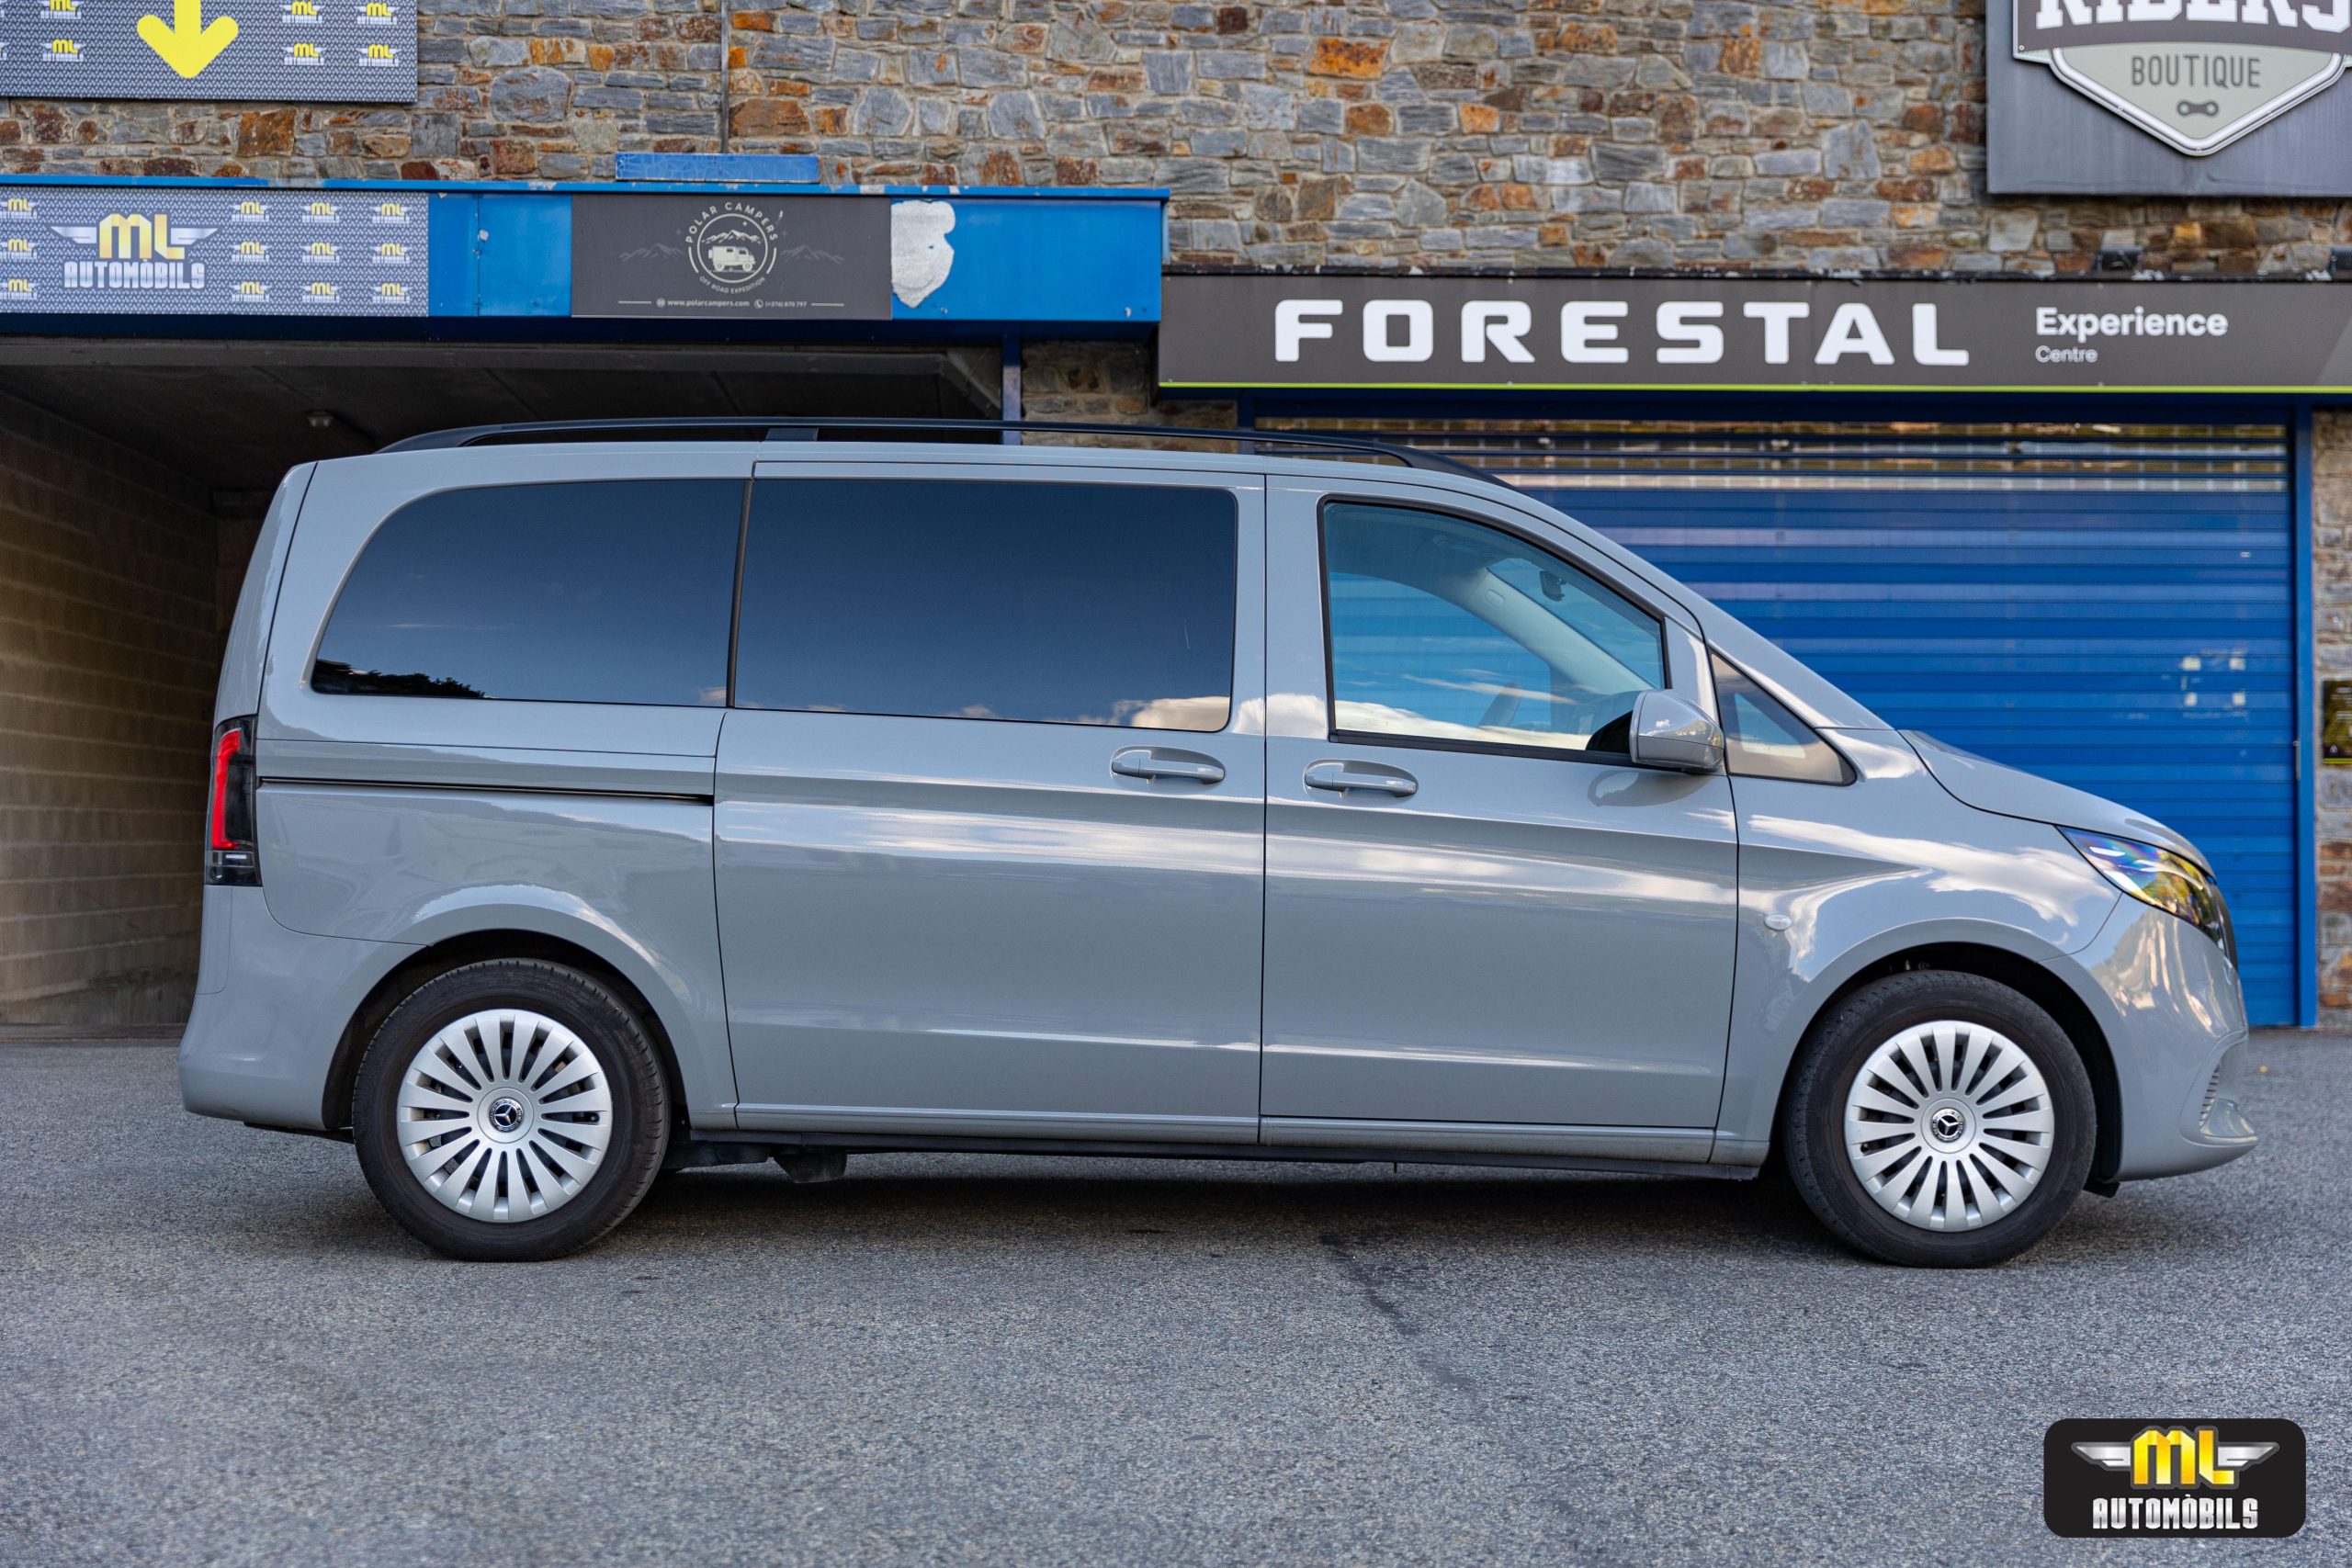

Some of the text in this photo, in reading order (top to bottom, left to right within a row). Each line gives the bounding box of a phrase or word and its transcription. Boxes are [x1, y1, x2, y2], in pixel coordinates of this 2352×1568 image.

[291, 0, 318, 15] ML
[367, 3, 392, 17] ML
[52, 39, 78, 54] ML
[294, 43, 319, 57] ML
[368, 44, 393, 59] ML
[2131, 55, 2261, 88] BOUTIQUE
[7, 197, 32, 211] ML
[241, 201, 265, 215] ML
[311, 202, 335, 215] ML
[381, 203, 405, 216] ML
[684, 202, 778, 243] POLAR CAMPERS
[98, 213, 186, 259] ML
[7, 239, 32, 252] ML
[241, 242, 265, 254] ML
[311, 243, 335, 255] ML
[381, 243, 405, 255] ML
[7, 278, 32, 292] ML
[241, 281, 265, 295] ML
[311, 282, 335, 295] ML
[381, 283, 405, 296] ML
[711, 284, 729, 294] ROAD
[667, 299, 750, 308] www.polarcampers.com
[2036, 306, 2229, 344] Experience
[1273, 299, 1970, 367] FORESTAL
[2035, 345, 2098, 363] Centre
